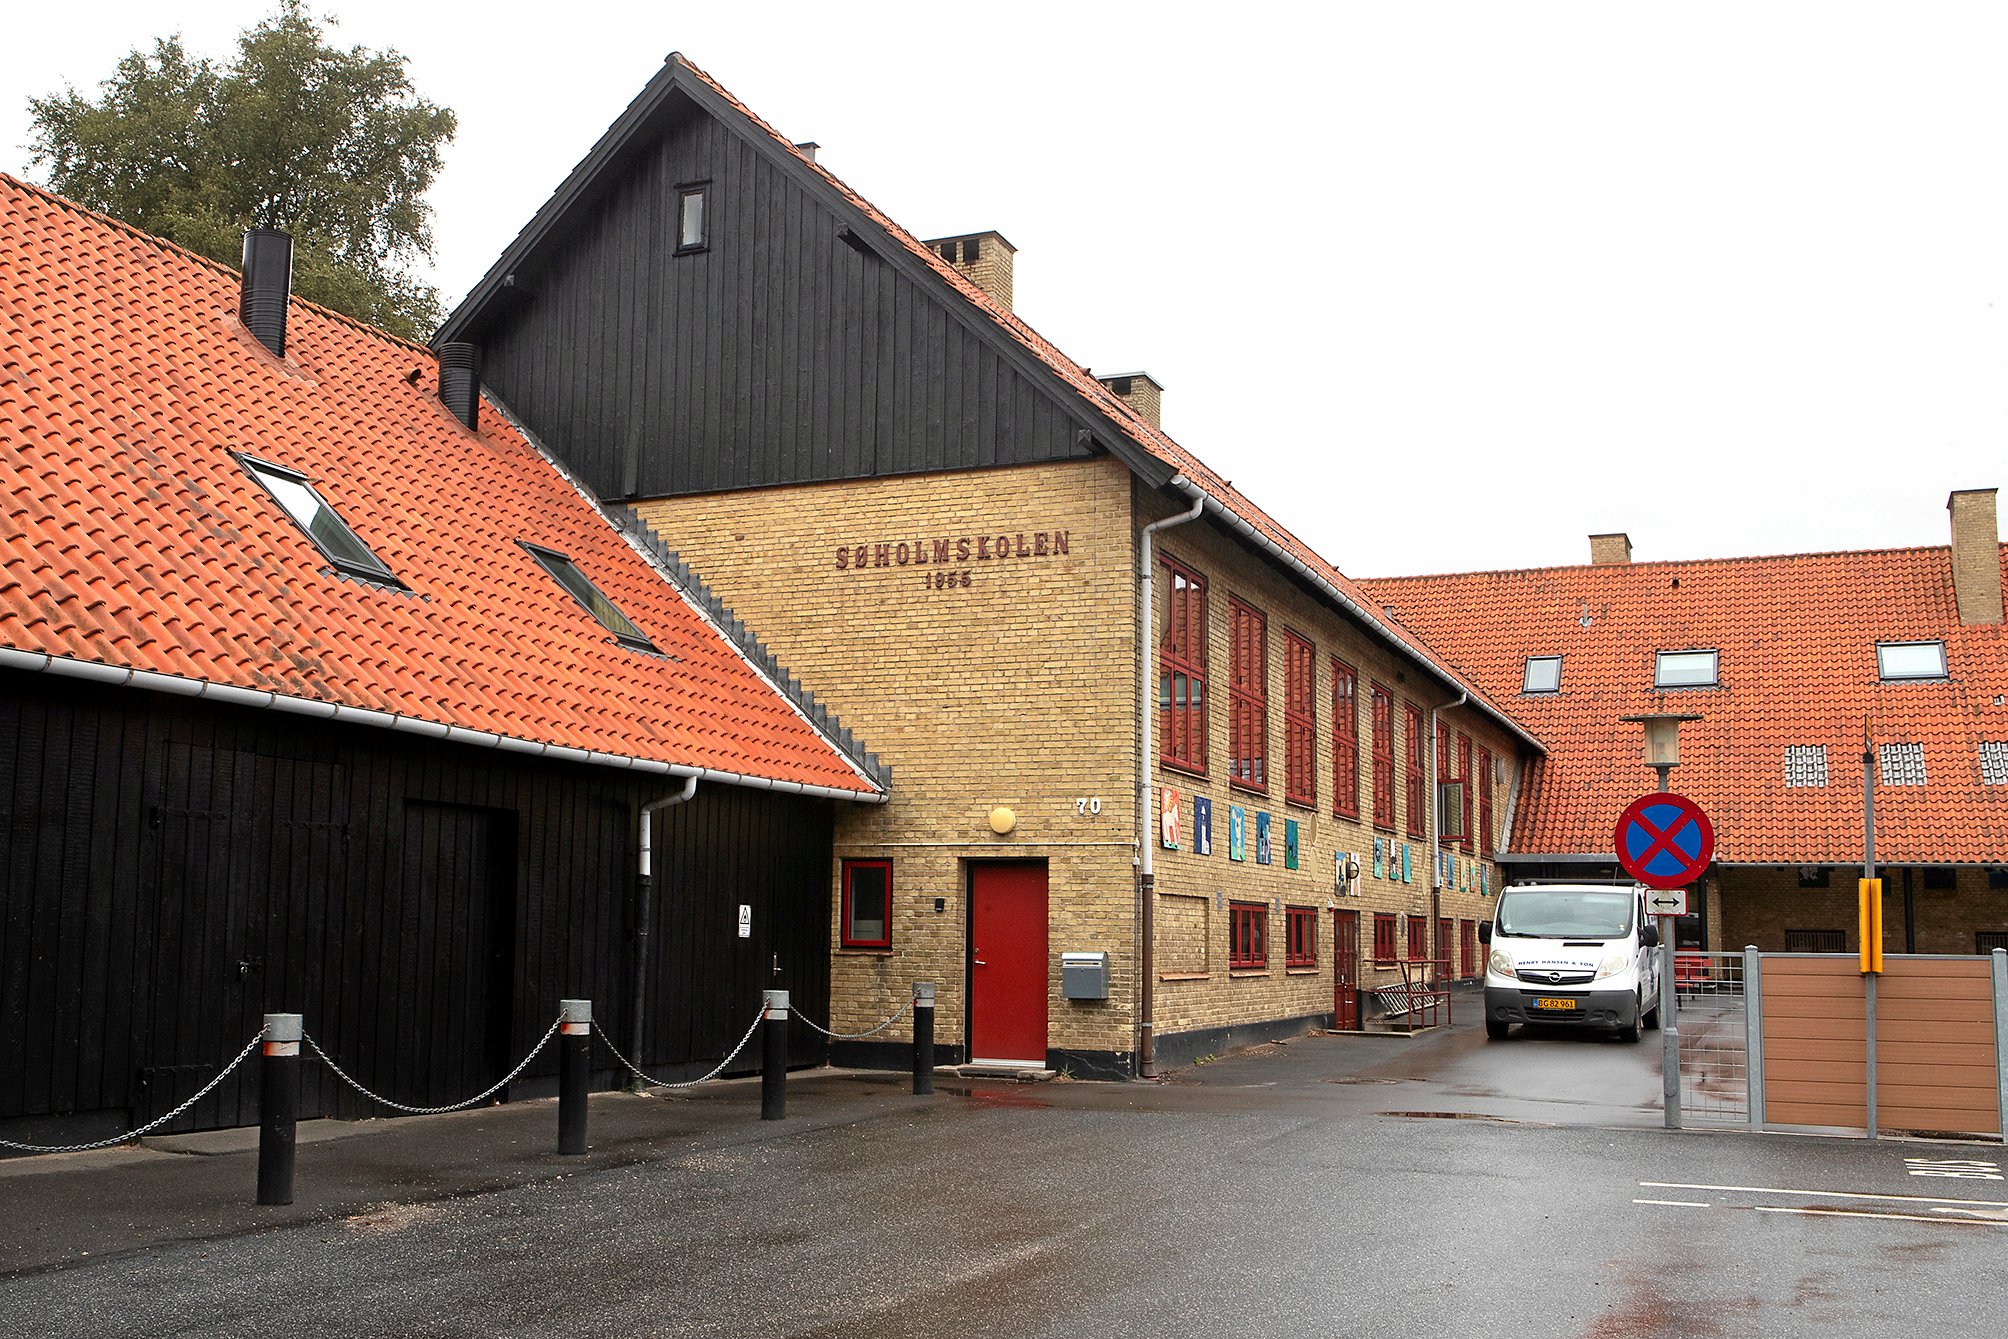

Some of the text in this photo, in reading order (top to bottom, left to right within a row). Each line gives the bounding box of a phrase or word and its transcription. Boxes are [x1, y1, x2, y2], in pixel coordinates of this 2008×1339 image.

[836, 530, 1070, 569] SØHOLMSKOLEN
[924, 570, 972, 589] 1955
[1076, 797, 1101, 815] 70
[1560, 1000, 1574, 1008] 961
